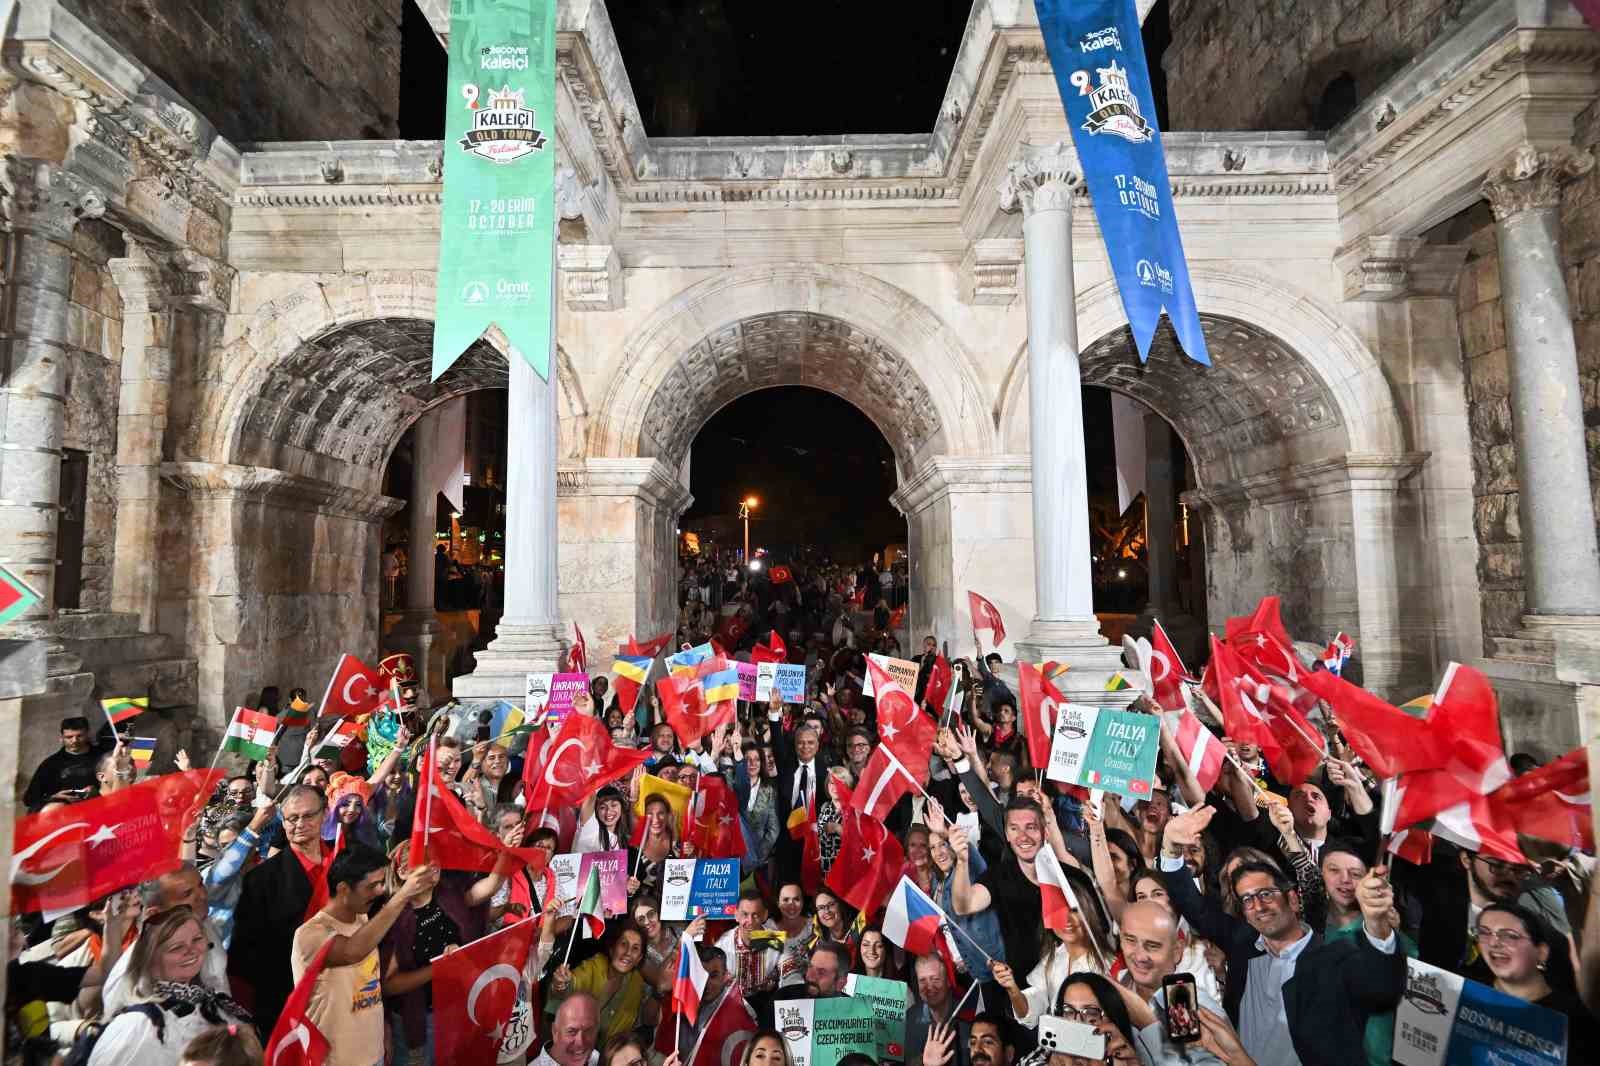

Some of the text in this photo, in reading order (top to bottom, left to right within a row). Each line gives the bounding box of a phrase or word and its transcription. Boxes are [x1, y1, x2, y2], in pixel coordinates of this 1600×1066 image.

[476, 130, 533, 141] OLD TOWN
[1114, 174, 1126, 189] 17
[468, 215, 535, 230] OCTOBER
[552, 681, 585, 691] UKRAYNA
[1106, 719, 1146, 742] İTALYA
[702, 862, 731, 875] İTALYA
[1459, 1006, 1504, 1034] BOSNA
[816, 1031, 874, 1045] CZECH REPUBLIC
